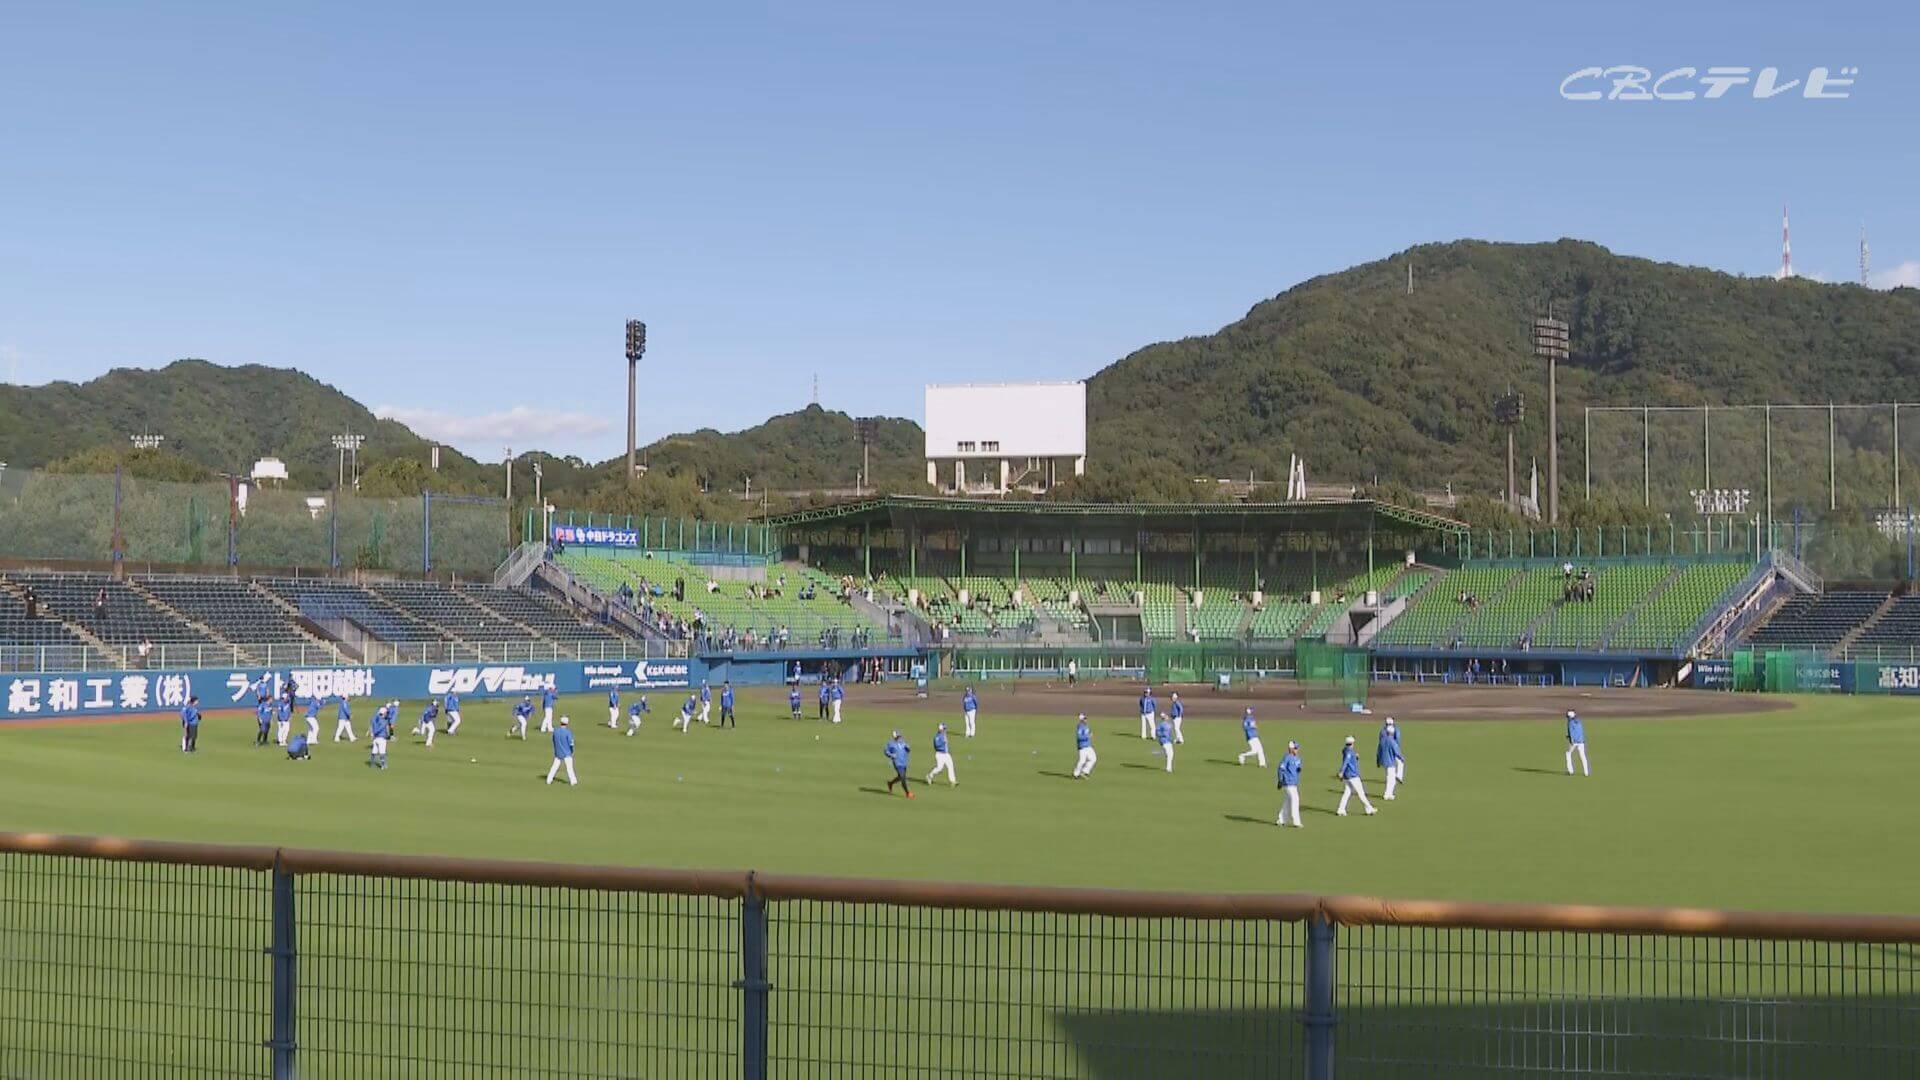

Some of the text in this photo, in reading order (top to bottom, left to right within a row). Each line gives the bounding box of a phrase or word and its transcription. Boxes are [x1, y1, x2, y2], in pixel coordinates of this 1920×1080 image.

[8, 673, 192, 713] 紀和工業(株)
[1878, 666, 1920, 689] 高知
